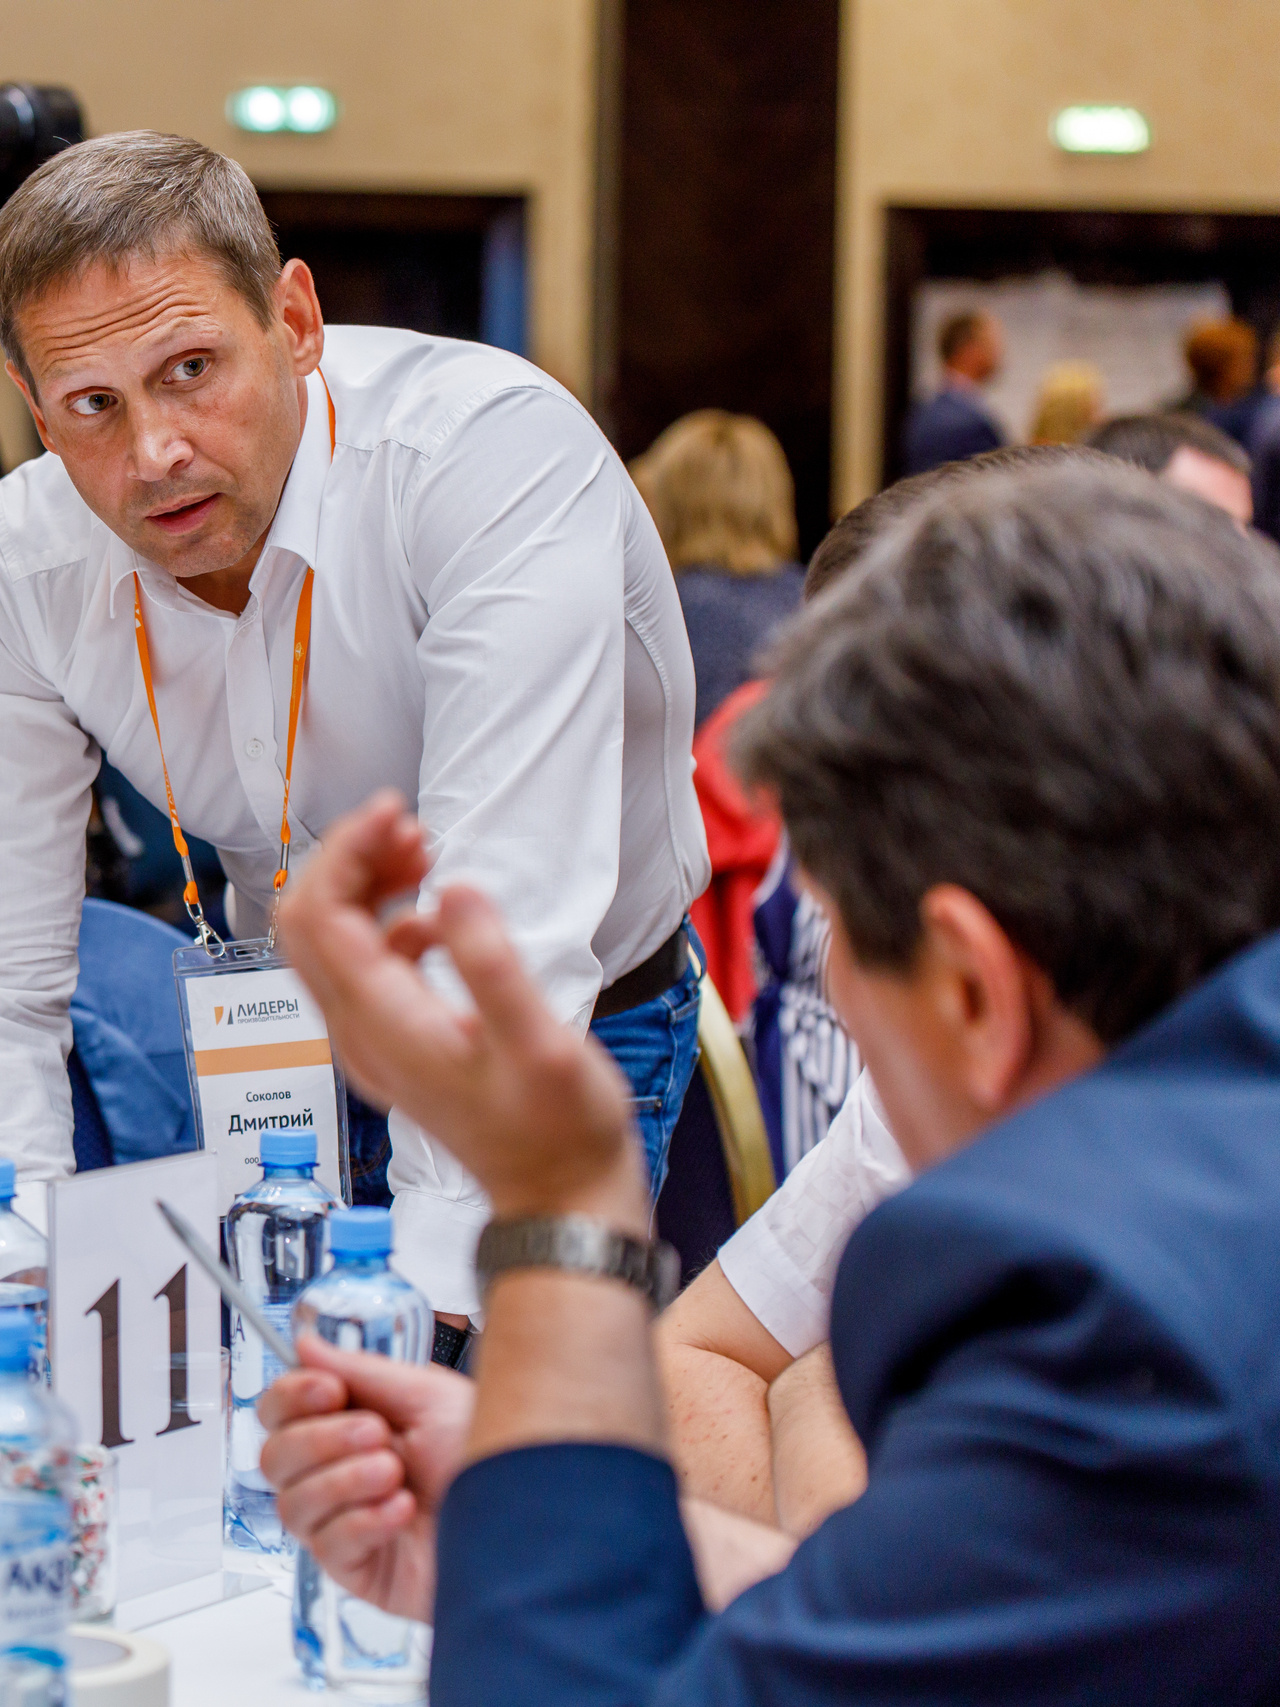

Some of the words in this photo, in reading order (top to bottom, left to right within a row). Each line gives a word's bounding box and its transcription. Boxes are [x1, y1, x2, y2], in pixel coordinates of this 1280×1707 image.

[237, 999, 299, 1017] ЛИДЕРЫ
[237, 1013, 300, 1024] ПРОИЗВОДИТЕЛЬНОСТИ
[246, 1091, 292, 1102] Соколов
[228, 1108, 313, 1136] Дмитрий
[84, 1263, 202, 1449] 11
